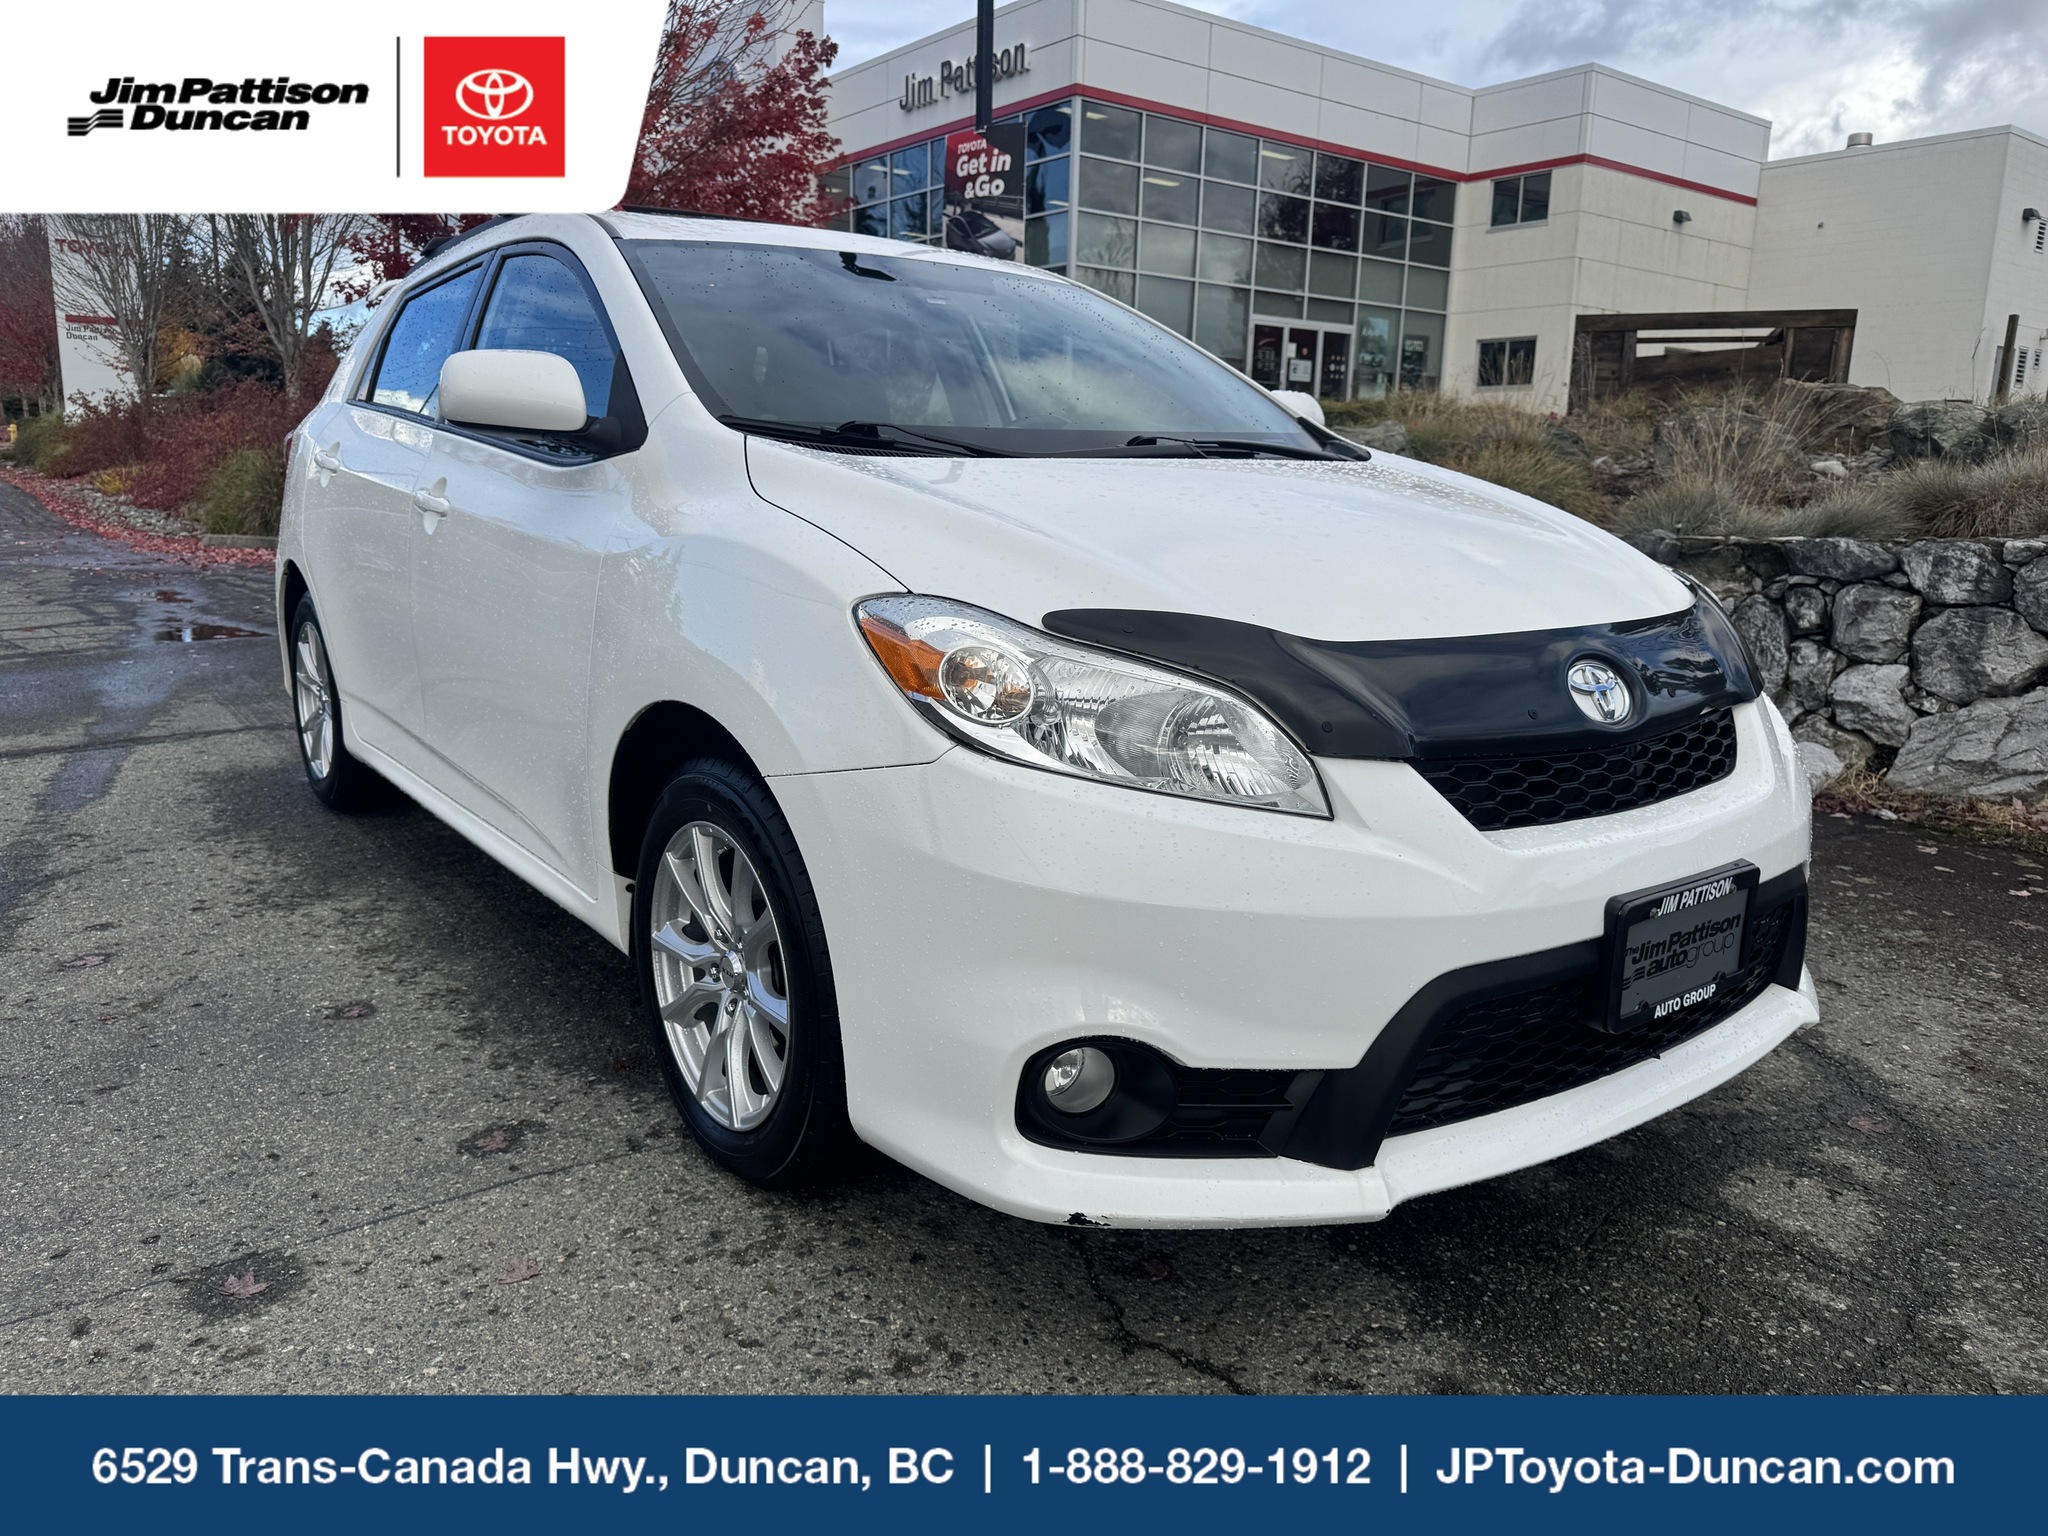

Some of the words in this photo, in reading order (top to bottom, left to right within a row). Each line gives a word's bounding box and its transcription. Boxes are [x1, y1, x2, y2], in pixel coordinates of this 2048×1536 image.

[899, 72, 935, 111] Jim
[941, 43, 1026, 97] Patson
[956, 153, 989, 178] Get
[990, 147, 1012, 173] in
[957, 138, 988, 155] TOYOTA
[1657, 893, 1680, 917] JIM
[1680, 876, 1734, 910] PATTISON
[1654, 997, 1682, 1019] AUTO
[1683, 983, 1717, 1007] GROUP
